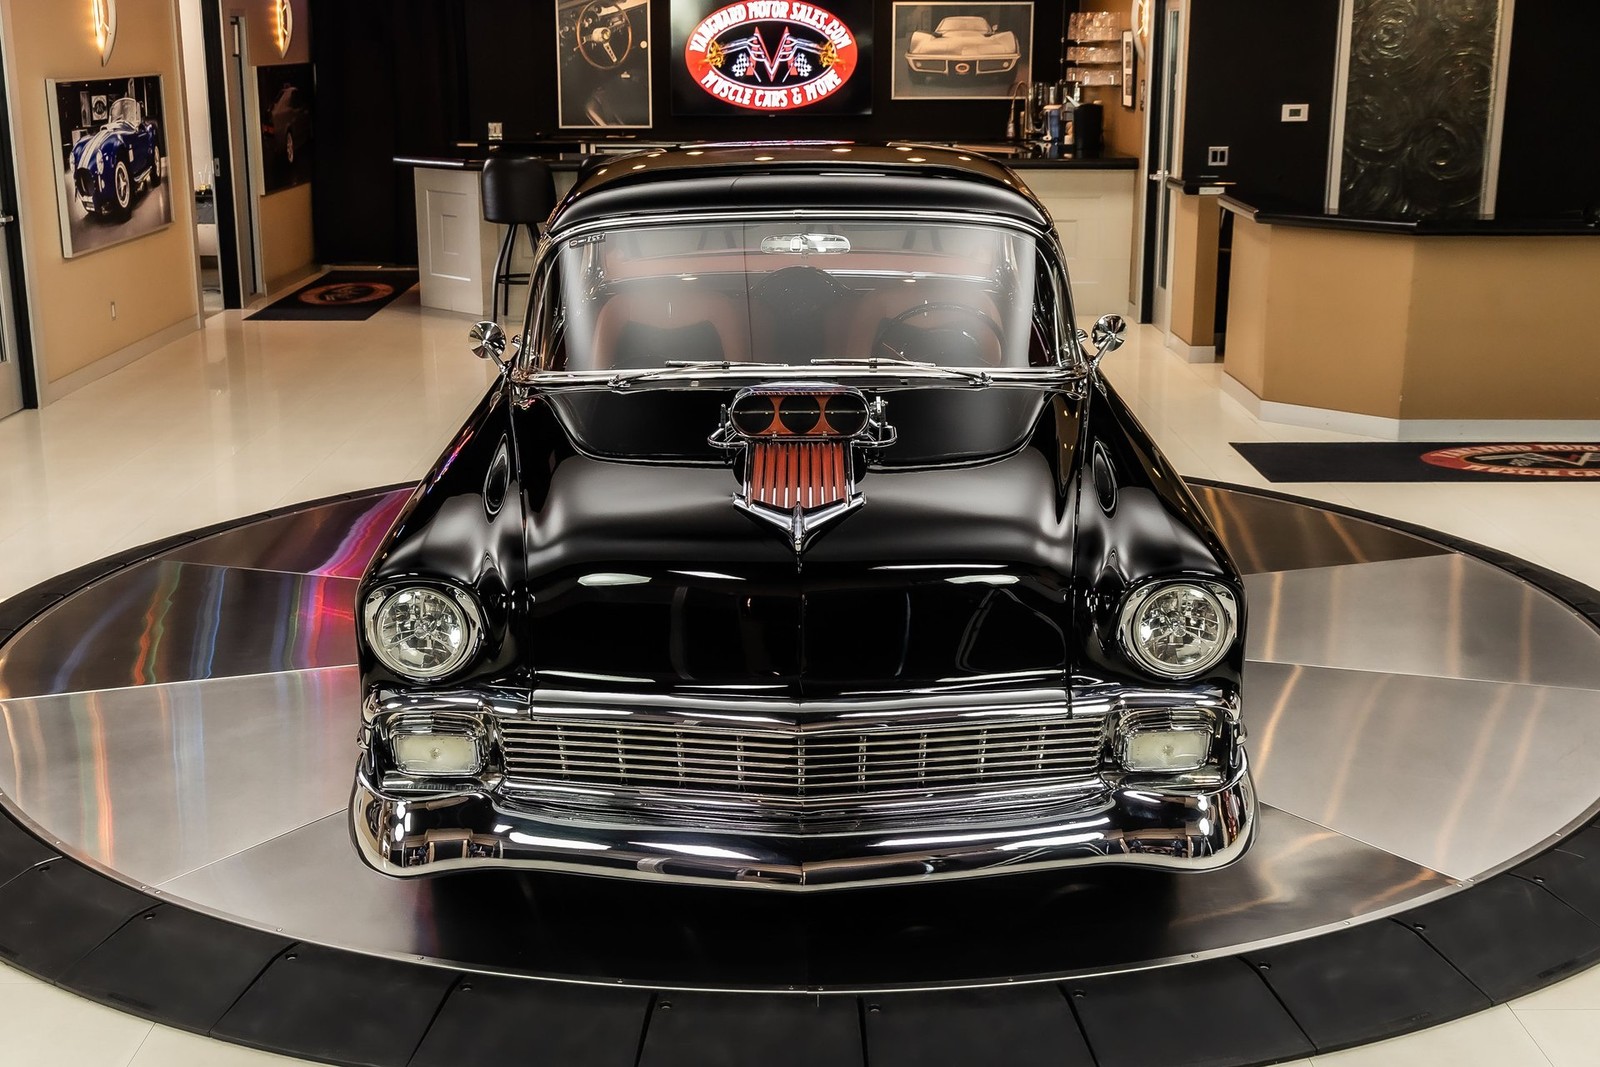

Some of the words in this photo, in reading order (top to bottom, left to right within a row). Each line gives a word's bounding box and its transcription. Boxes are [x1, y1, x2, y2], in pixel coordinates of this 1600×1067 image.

[691, 4, 747, 52] VANGUARD
[748, 1, 789, 19] MOTOR
[790, 3, 852, 49] SALES.COM
[701, 70, 753, 105] MUSCLE
[754, 90, 788, 107] CARS
[793, 88, 803, 105] &
[804, 70, 842, 102] MORE
[1462, 464, 1560, 476] MUSCLE
